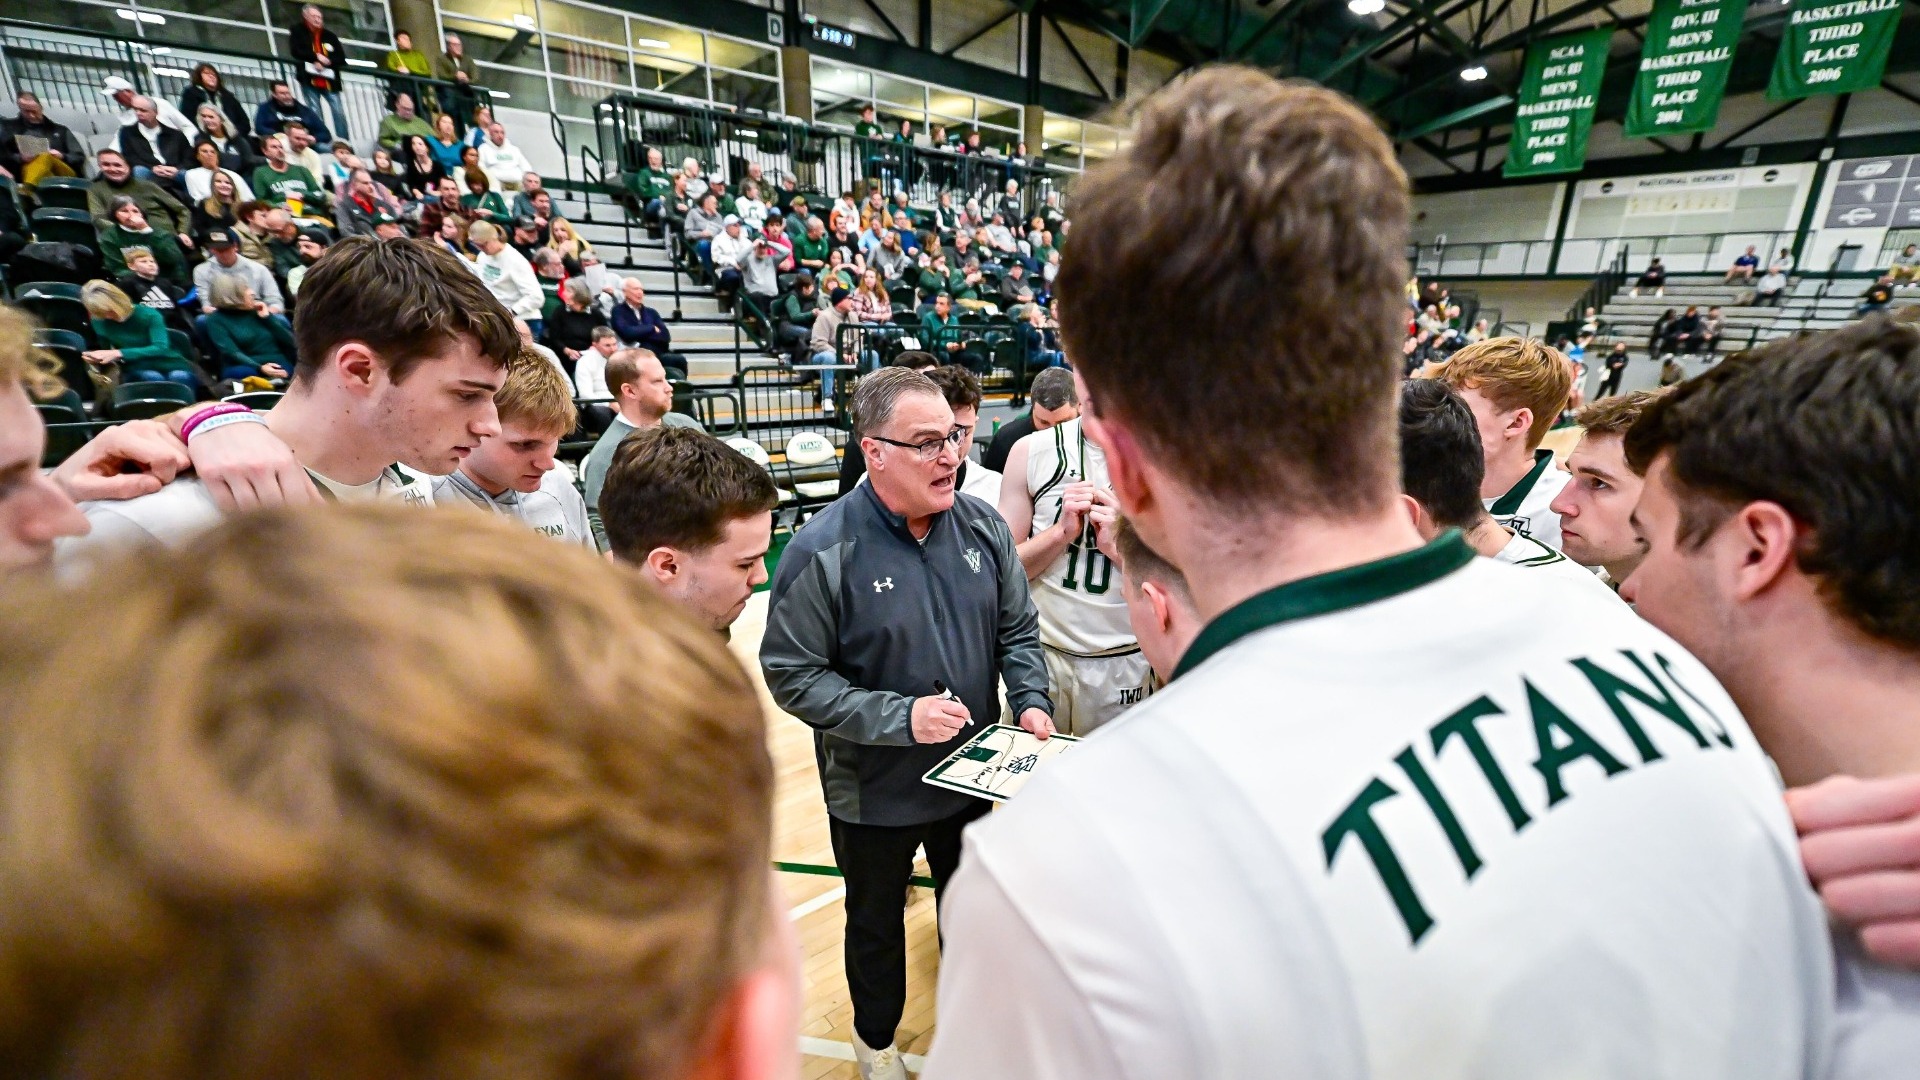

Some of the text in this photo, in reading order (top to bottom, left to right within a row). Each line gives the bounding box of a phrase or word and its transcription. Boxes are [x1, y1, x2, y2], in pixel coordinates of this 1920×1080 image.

[1792, 0, 1900, 24] BASKETBALL
[770, 18, 781, 36] D
[1809, 21, 1864, 43] THIRD
[1640, 46, 1731, 71] BASKETBALL
[1802, 43, 1860, 65] PLACE
[1656, 70, 1702, 88] THIRD
[1806, 66, 1843, 84] 2006
[1517, 95, 1594, 117] BASKETBALL
[1651, 89, 1699, 107] PLACE
[1531, 116, 1570, 131] THIRD
[1527, 133, 1568, 149] PLACE
[1062, 547, 1112, 596] 10
[1120, 686, 1143, 705] IWU
[1320, 649, 1736, 949] TITANS
